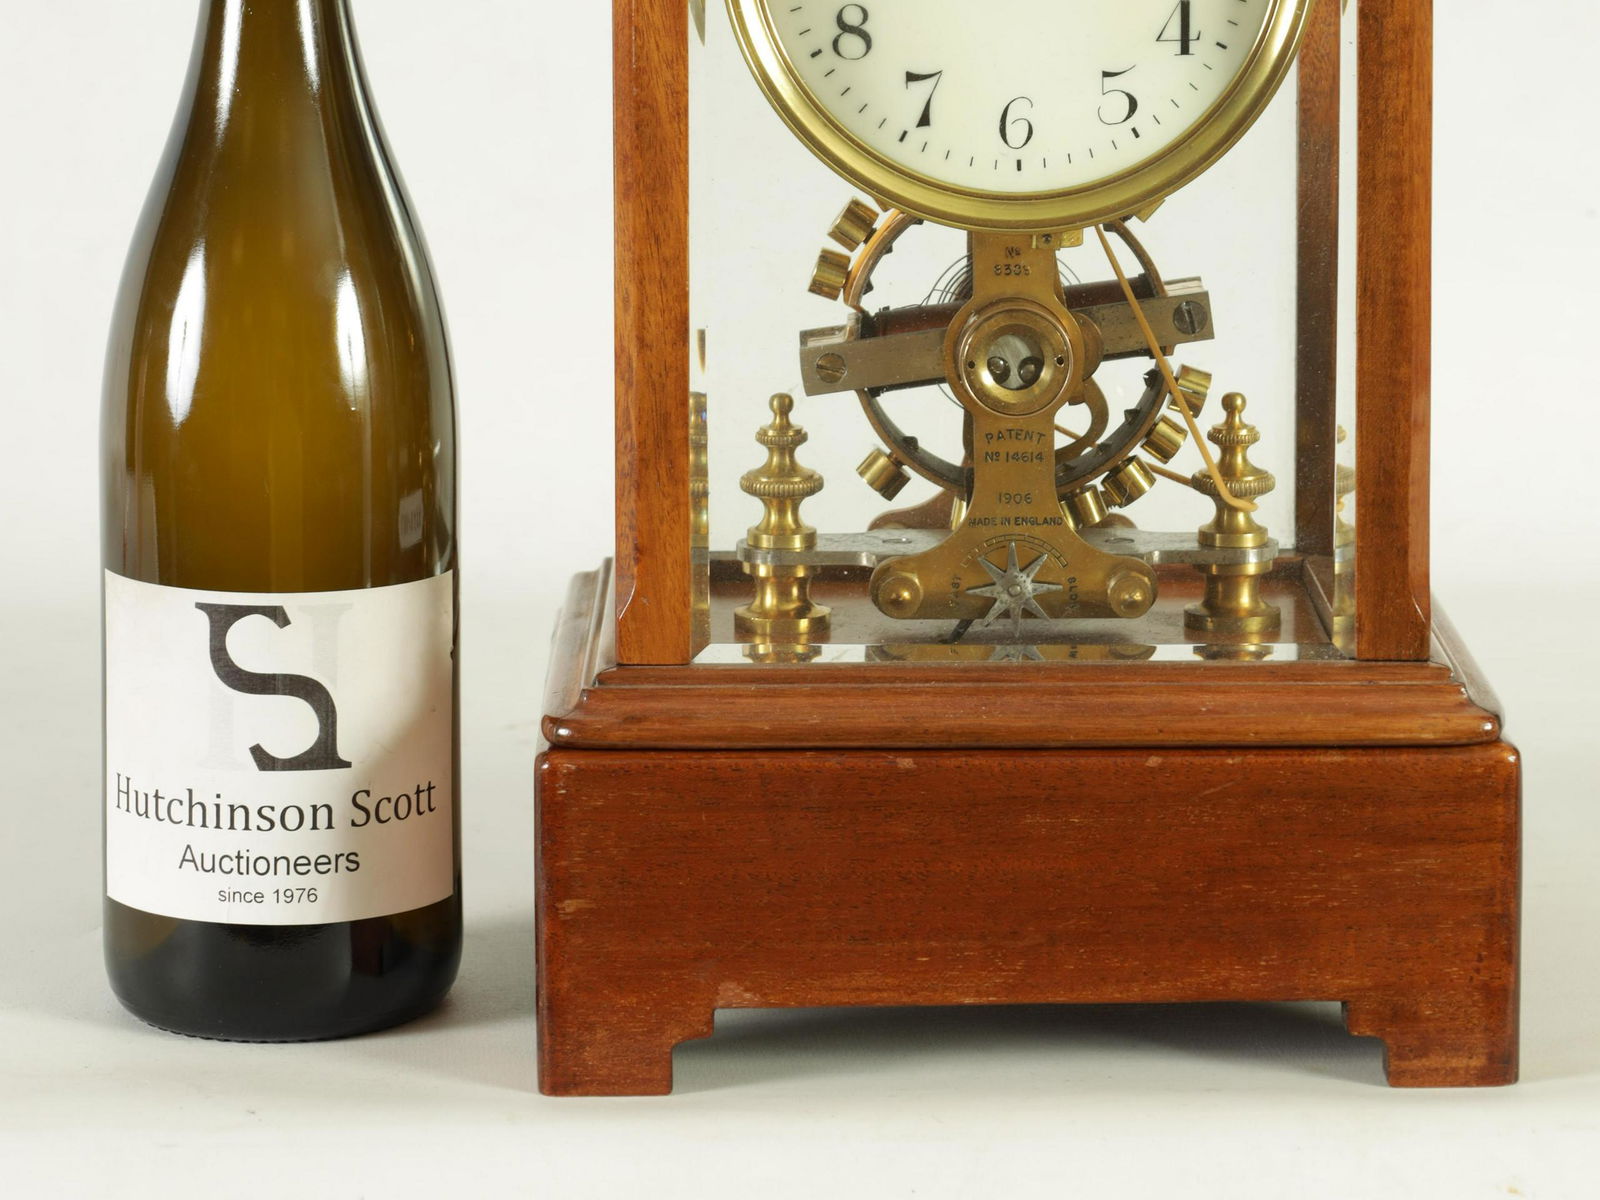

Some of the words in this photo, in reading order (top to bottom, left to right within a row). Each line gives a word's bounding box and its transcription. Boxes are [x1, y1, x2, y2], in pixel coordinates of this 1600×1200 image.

[832, 3, 872, 60] 8
[1155, 0, 1201, 56] 4
[905, 69, 943, 128] 7
[1098, 64, 1137, 126] 5
[999, 96, 1033, 149] 6
[985, 428, 1046, 444] PATENT
[1005, 451, 1044, 463] 14614
[998, 492, 1033, 504] 1906
[968, 517, 997, 527] MADE
[1000, 517, 1010, 526] IN
[1014, 517, 1063, 526] ENGLAND
[116, 772, 335, 832] Hutchinson
[351, 781, 436, 828] Scott
[178, 844, 360, 876] Auctioneers
[218, 888, 264, 904] since
[272, 888, 318, 903] 1976
